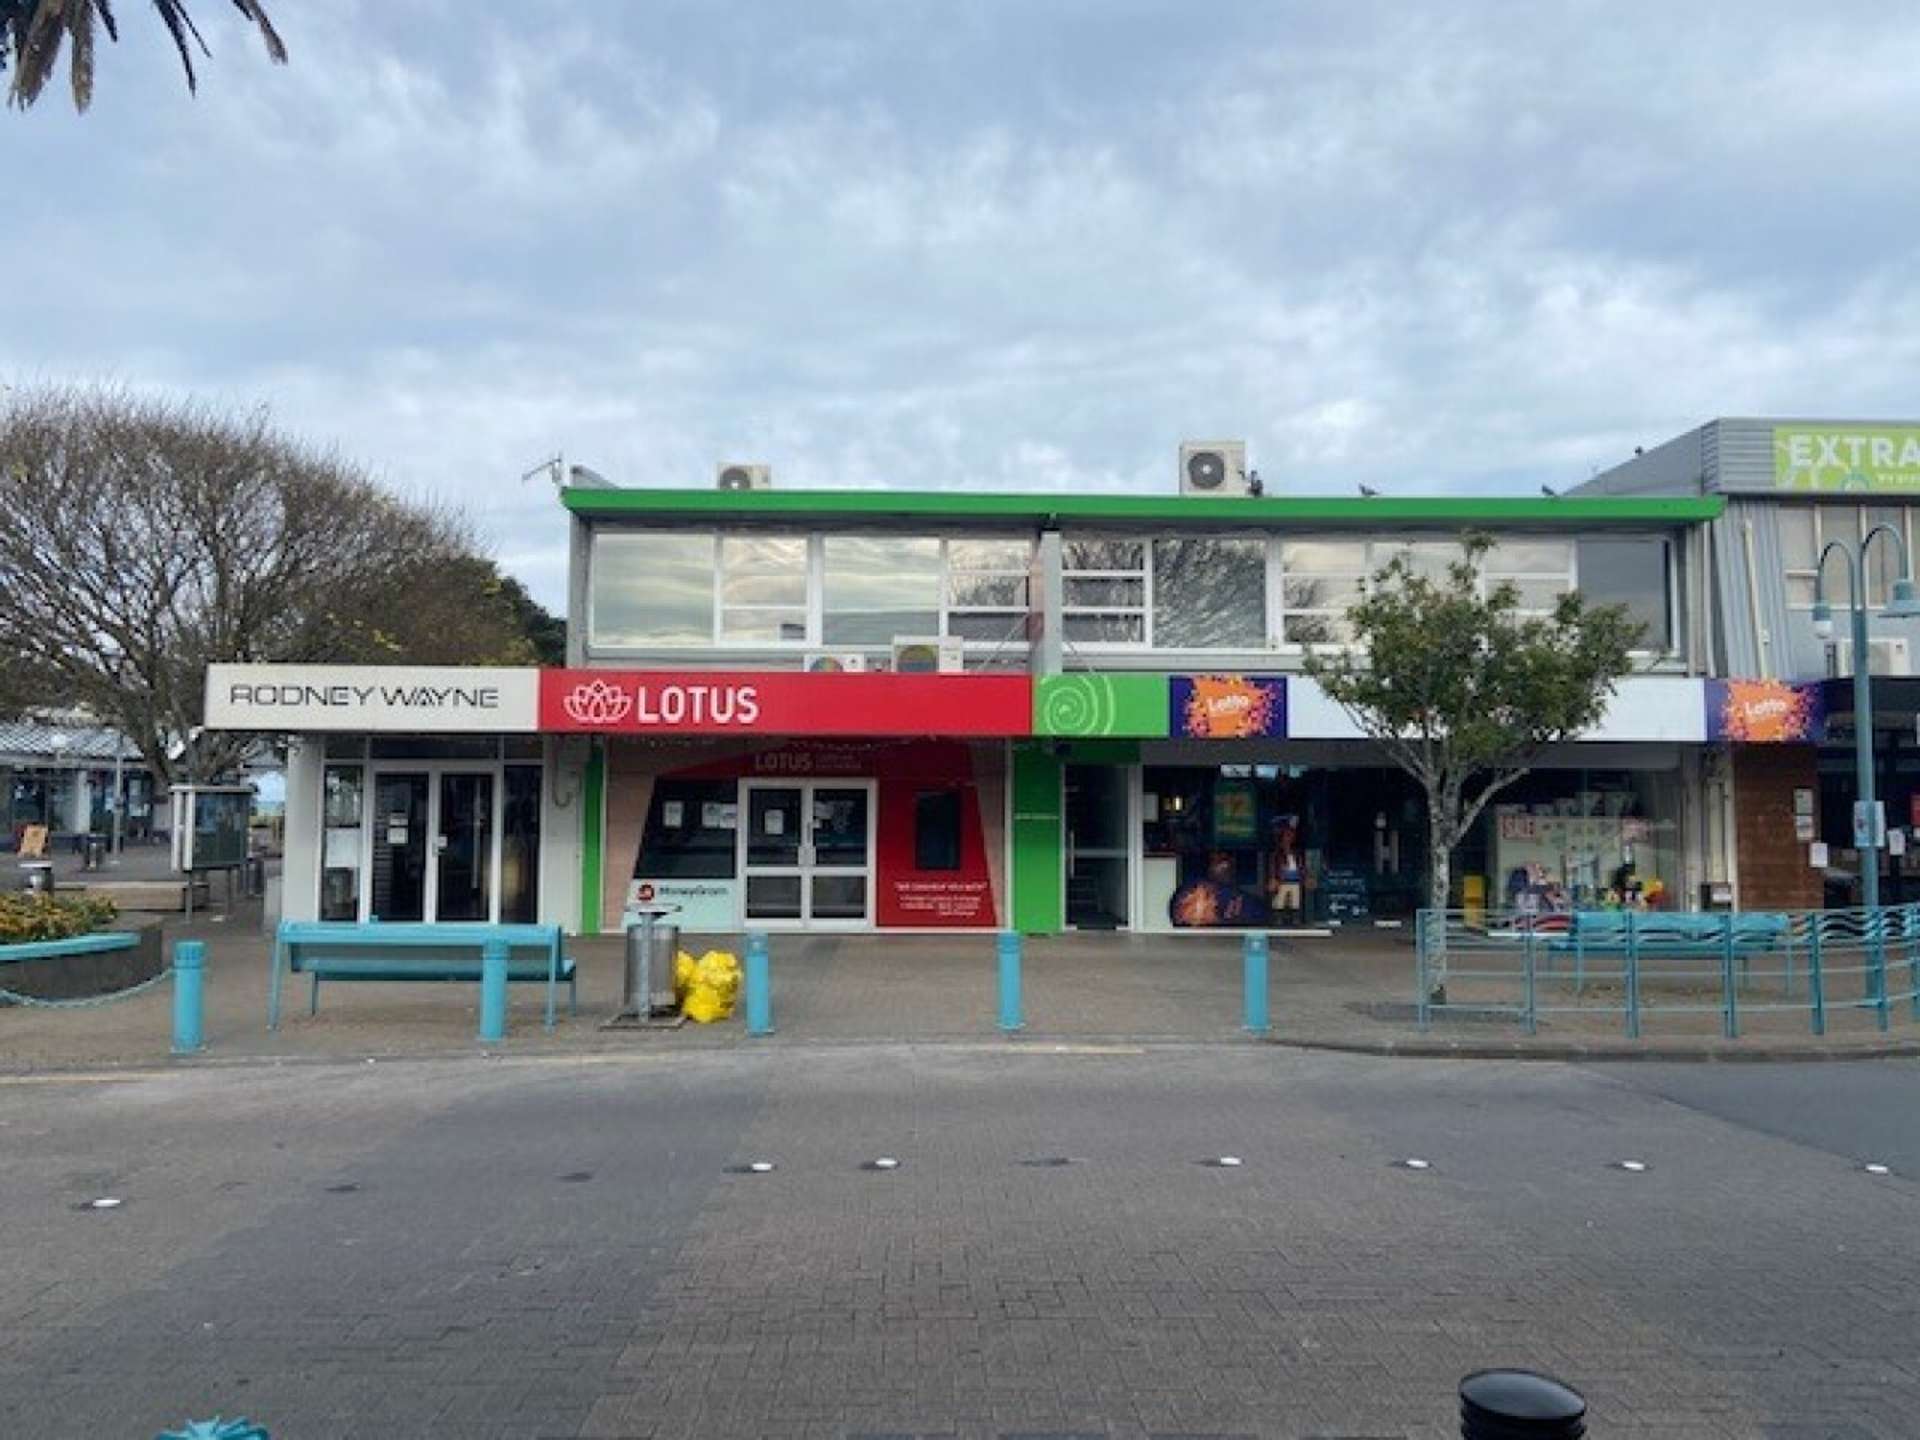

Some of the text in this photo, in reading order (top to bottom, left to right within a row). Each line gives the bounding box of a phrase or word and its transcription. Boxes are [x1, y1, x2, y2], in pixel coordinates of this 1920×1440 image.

[1789, 434, 1919, 468] EXTRA
[230, 685, 499, 708] RODNEY WAYNE
[637, 685, 759, 724] LOTUS
[1744, 698, 1787, 715] Lotto
[755, 752, 812, 770] LOTUS
